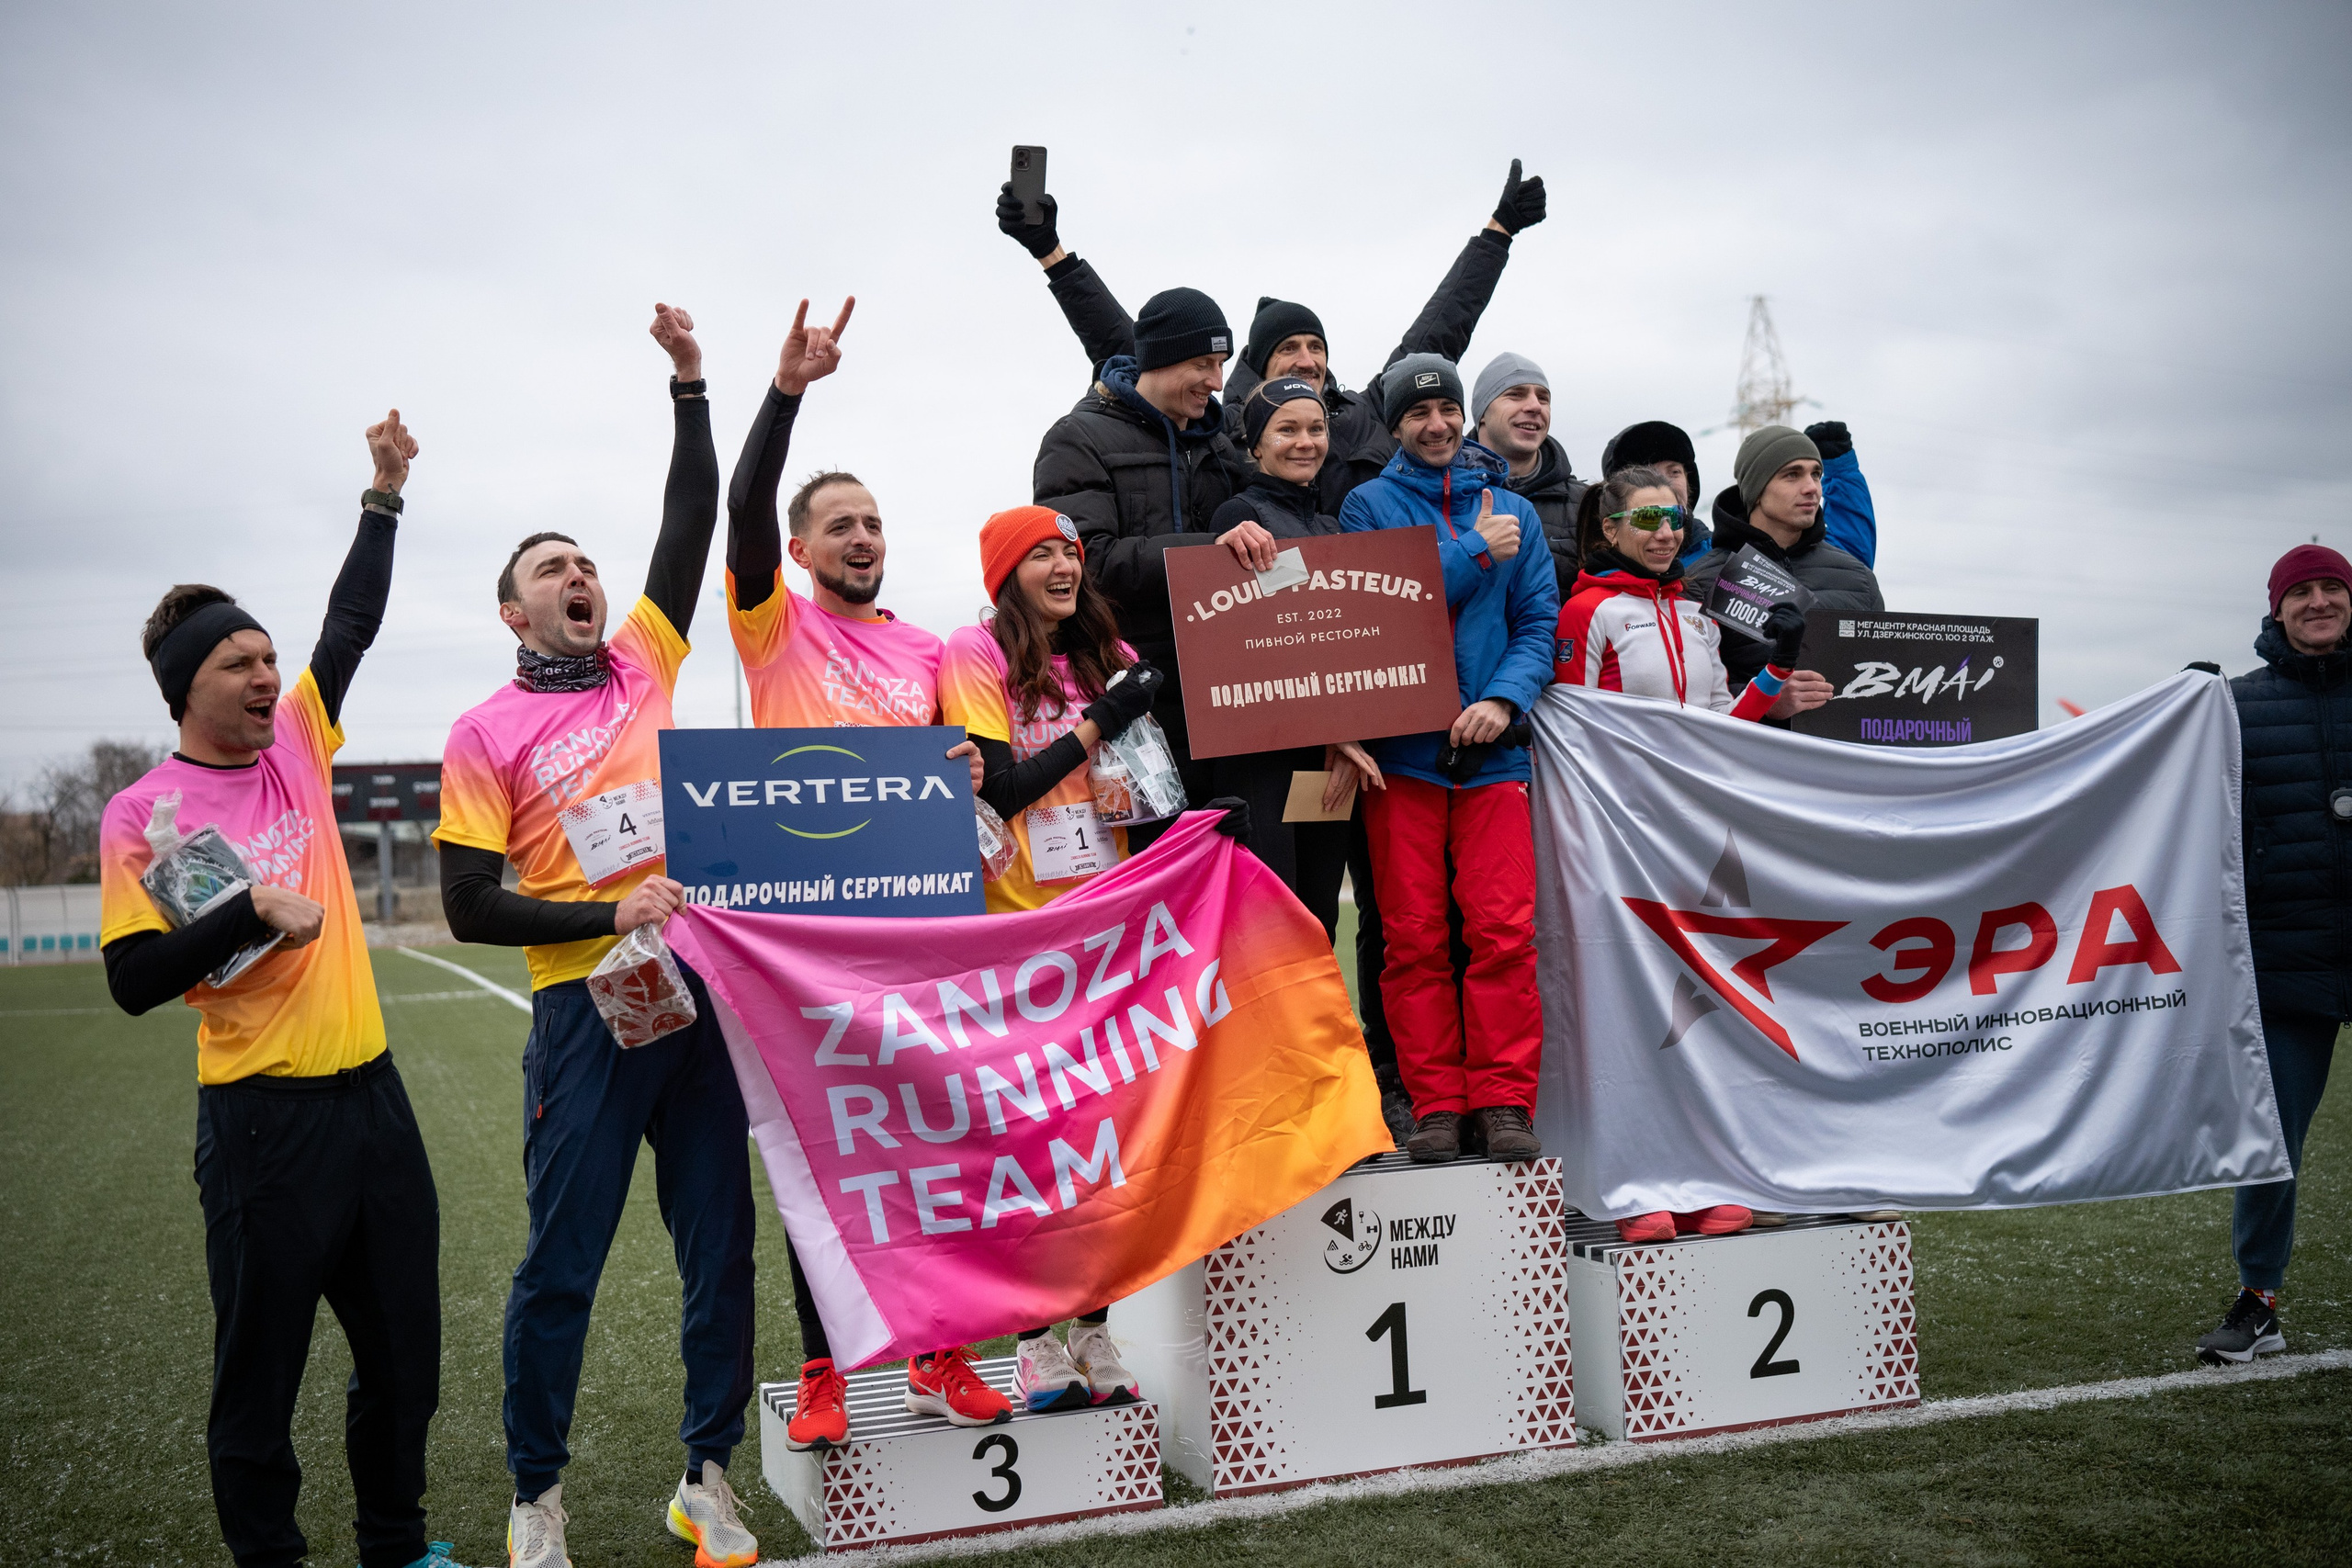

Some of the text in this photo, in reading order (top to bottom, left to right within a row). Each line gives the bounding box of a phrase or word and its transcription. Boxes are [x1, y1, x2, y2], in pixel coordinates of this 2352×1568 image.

[1193, 580, 1276, 621] LOUI
[1718, 578, 1757, 603] ПОДАРОЧНЫЙ
[1277, 608, 1342, 624] EST. 2022
[1624, 622, 1657, 632] FORWARD
[1857, 621, 1906, 630] МЕГАЦЕНТР
[1907, 623, 1946, 632] КРАСНАЯ
[1947, 625, 1991, 635] ПЛОЩАДЬ
[1245, 626, 1380, 649] ПИВНОЙ РЕСТОРАН
[1968, 635, 1995, 643] ЭТАЖ
[1210, 663, 1426, 707] ПОДАРОЧНЫЙ СЕРТИФИКАТ
[1860, 717, 1972, 742] ПОДАРОЧНЫЙ
[682, 776, 955, 807] VERTERA
[619, 813, 637, 835] 4
[1075, 827, 1089, 851] 1
[683, 872, 973, 909] ПОДАРОЧНЫЙ СЕРТИФИКАТ
[1860, 884, 2183, 1004] ЭРА
[799, 900, 1195, 1066] ZANOZA
[1859, 989, 2187, 1037] ВОЕННЫЙ ИННОВАЦИОННЫЙ
[825, 957, 1232, 1156] RUNNING
[1862, 1036, 2013, 1061] ТЕХНОПОЛИС
[839, 1116, 1127, 1245] TEAM
[1390, 1214, 1456, 1242] МЕЖДУ
[1391, 1244, 1439, 1269] НАМИ
[1747, 1289, 1800, 1379] 2
[1365, 1302, 1427, 1409] 1
[972, 1433, 1022, 1513] 3
